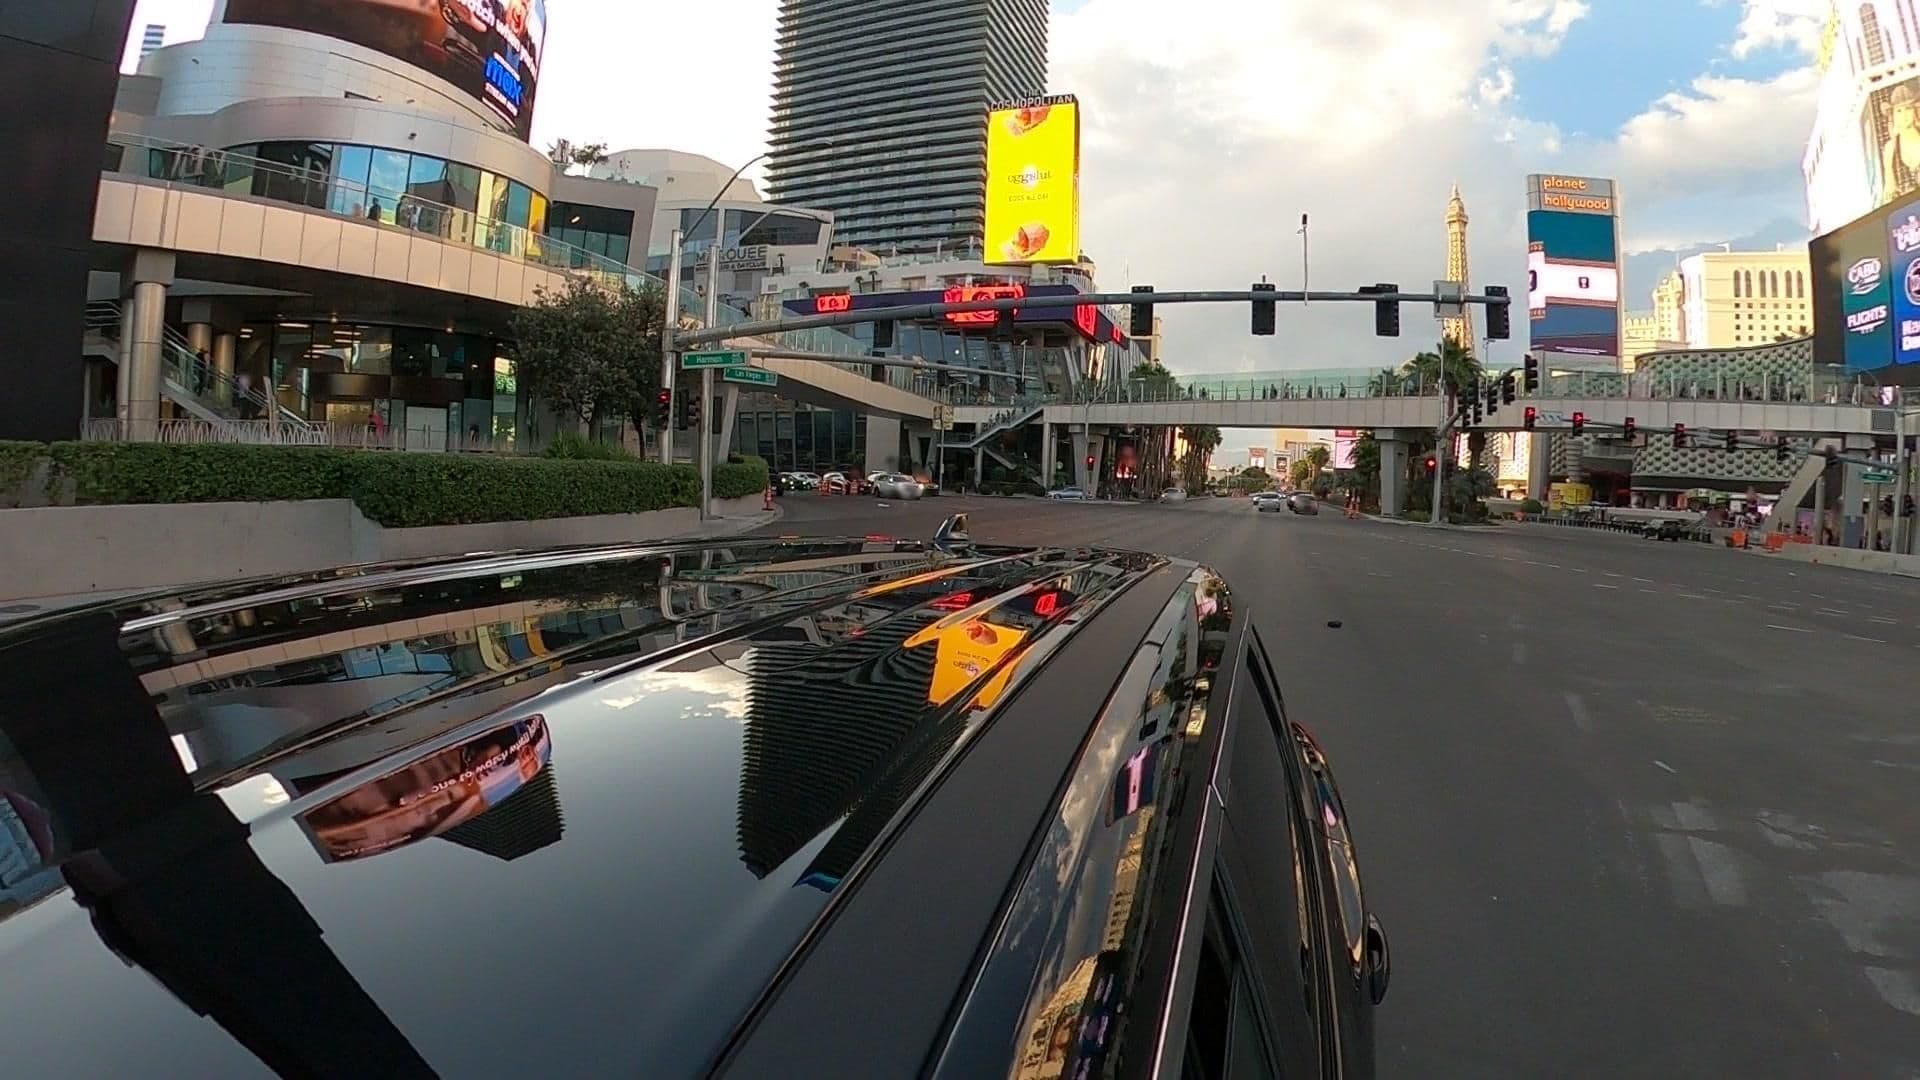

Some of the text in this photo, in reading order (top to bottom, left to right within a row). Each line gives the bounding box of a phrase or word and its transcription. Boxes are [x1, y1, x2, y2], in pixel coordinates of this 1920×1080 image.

[459, 0, 495, 27] atch
[991, 95, 1073, 111] COSMOPOLITAN
[1543, 176, 1586, 190] planet
[1544, 193, 1609, 210] hollywood
[1847, 305, 1887, 328] FLIGHTS
